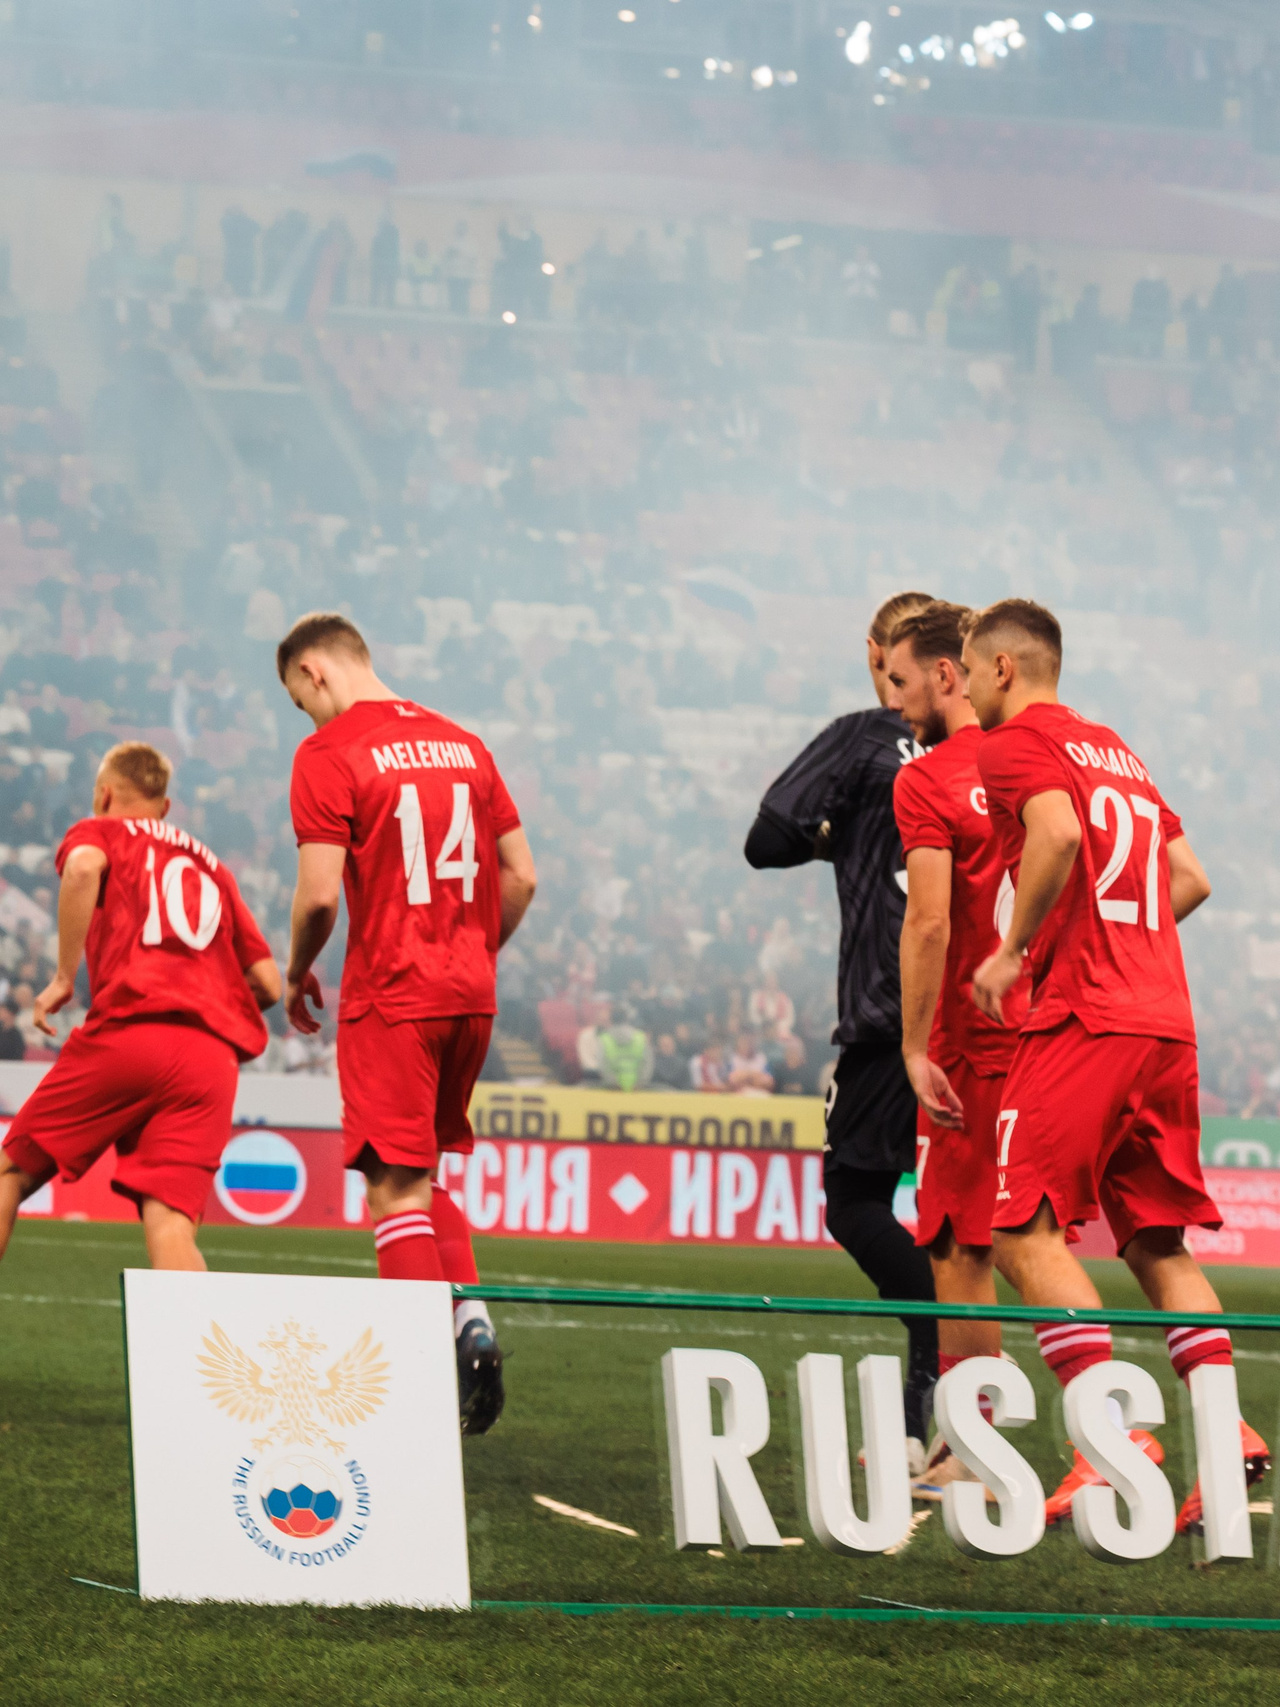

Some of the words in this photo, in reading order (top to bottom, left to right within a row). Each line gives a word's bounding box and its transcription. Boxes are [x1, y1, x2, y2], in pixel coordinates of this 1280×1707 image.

[371, 740, 477, 774] MELEKHIN
[393, 782, 480, 906] 14
[1089, 785, 1161, 932] 27
[141, 844, 223, 952] 10
[232, 1456, 257, 1490] THE
[343, 1459, 372, 1518] UNION
[661, 1346, 1254, 1566] RUSSI
[232, 1493, 287, 1562] RUSSIAN
[288, 1522, 368, 1568] FOOTBALL
